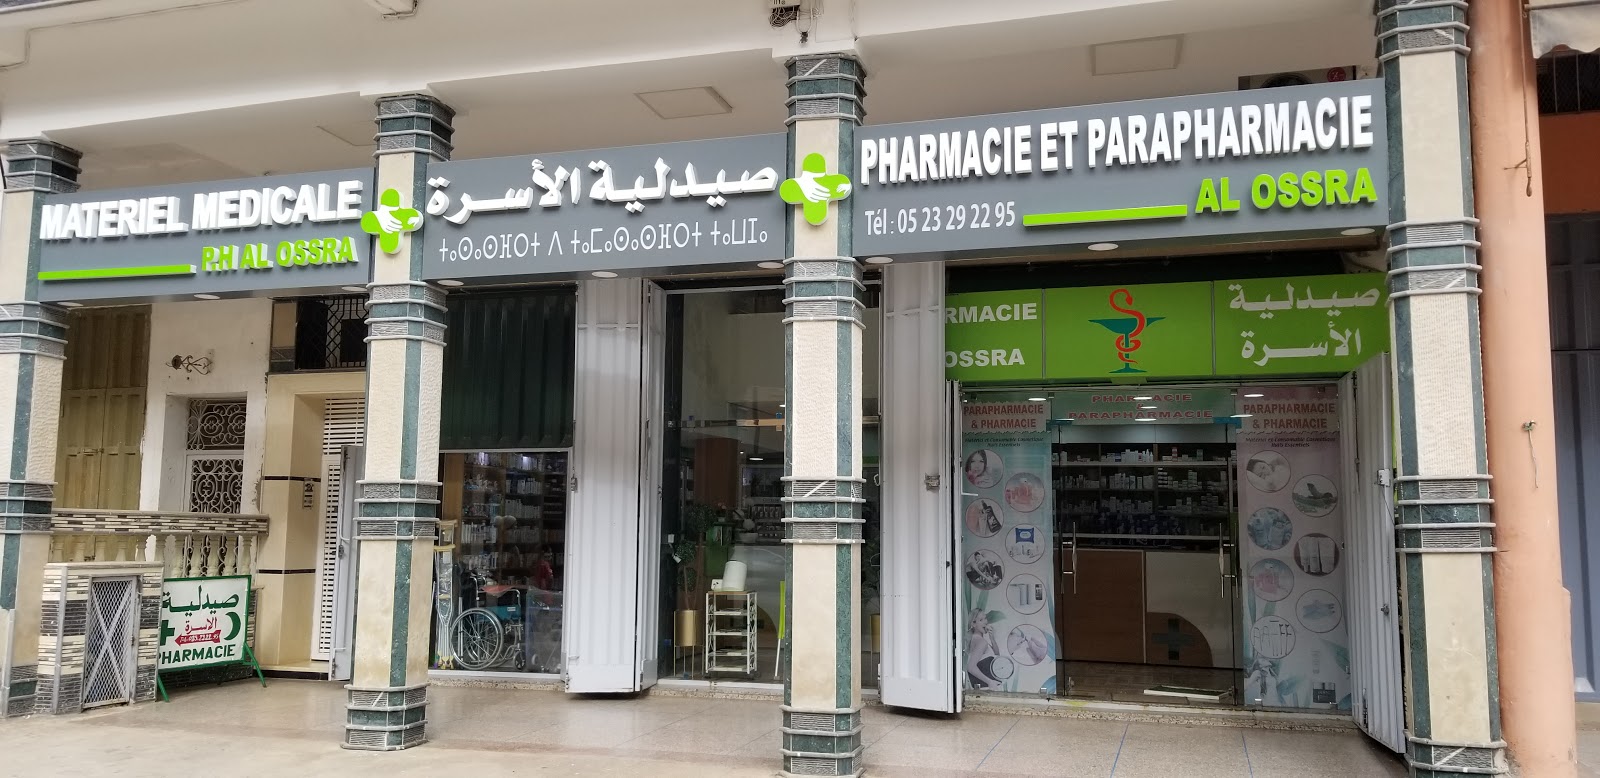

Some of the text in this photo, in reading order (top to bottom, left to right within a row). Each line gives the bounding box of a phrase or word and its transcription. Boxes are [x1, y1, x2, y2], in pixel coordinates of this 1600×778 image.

[861, 95, 1374, 186] PHARMACIE ET PARAPHARMACIE
[426, 157, 779, 225] صيدلية الأسرة
[1195, 167, 1378, 213] AL OSSRA
[39, 180, 363, 241] MATERIEL MEDICALE
[865, 208, 887, 235] Tél
[897, 208, 917, 234] 05
[921, 206, 942, 232] 23
[945, 204, 966, 230] 29
[970, 202, 991, 229] 22
[994, 201, 1016, 227] 95
[201, 235, 359, 272] P.H AL OSSRA
[1228, 282, 1381, 320] صيدلية
[945, 348, 1025, 368] OSSRA
[1240, 320, 1362, 367] الأسرة
[964, 404, 1044, 415] PARAPHARMACIE
[971, 418, 1037, 429] & PHARMACIE
[1068, 410, 1213, 419] PARAPHARMACIE
[1243, 402, 1335, 414] PARAPHARMACIE
[1252, 418, 1328, 429] & PHARMACIE
[158, 644, 236, 664] HARMACIE
